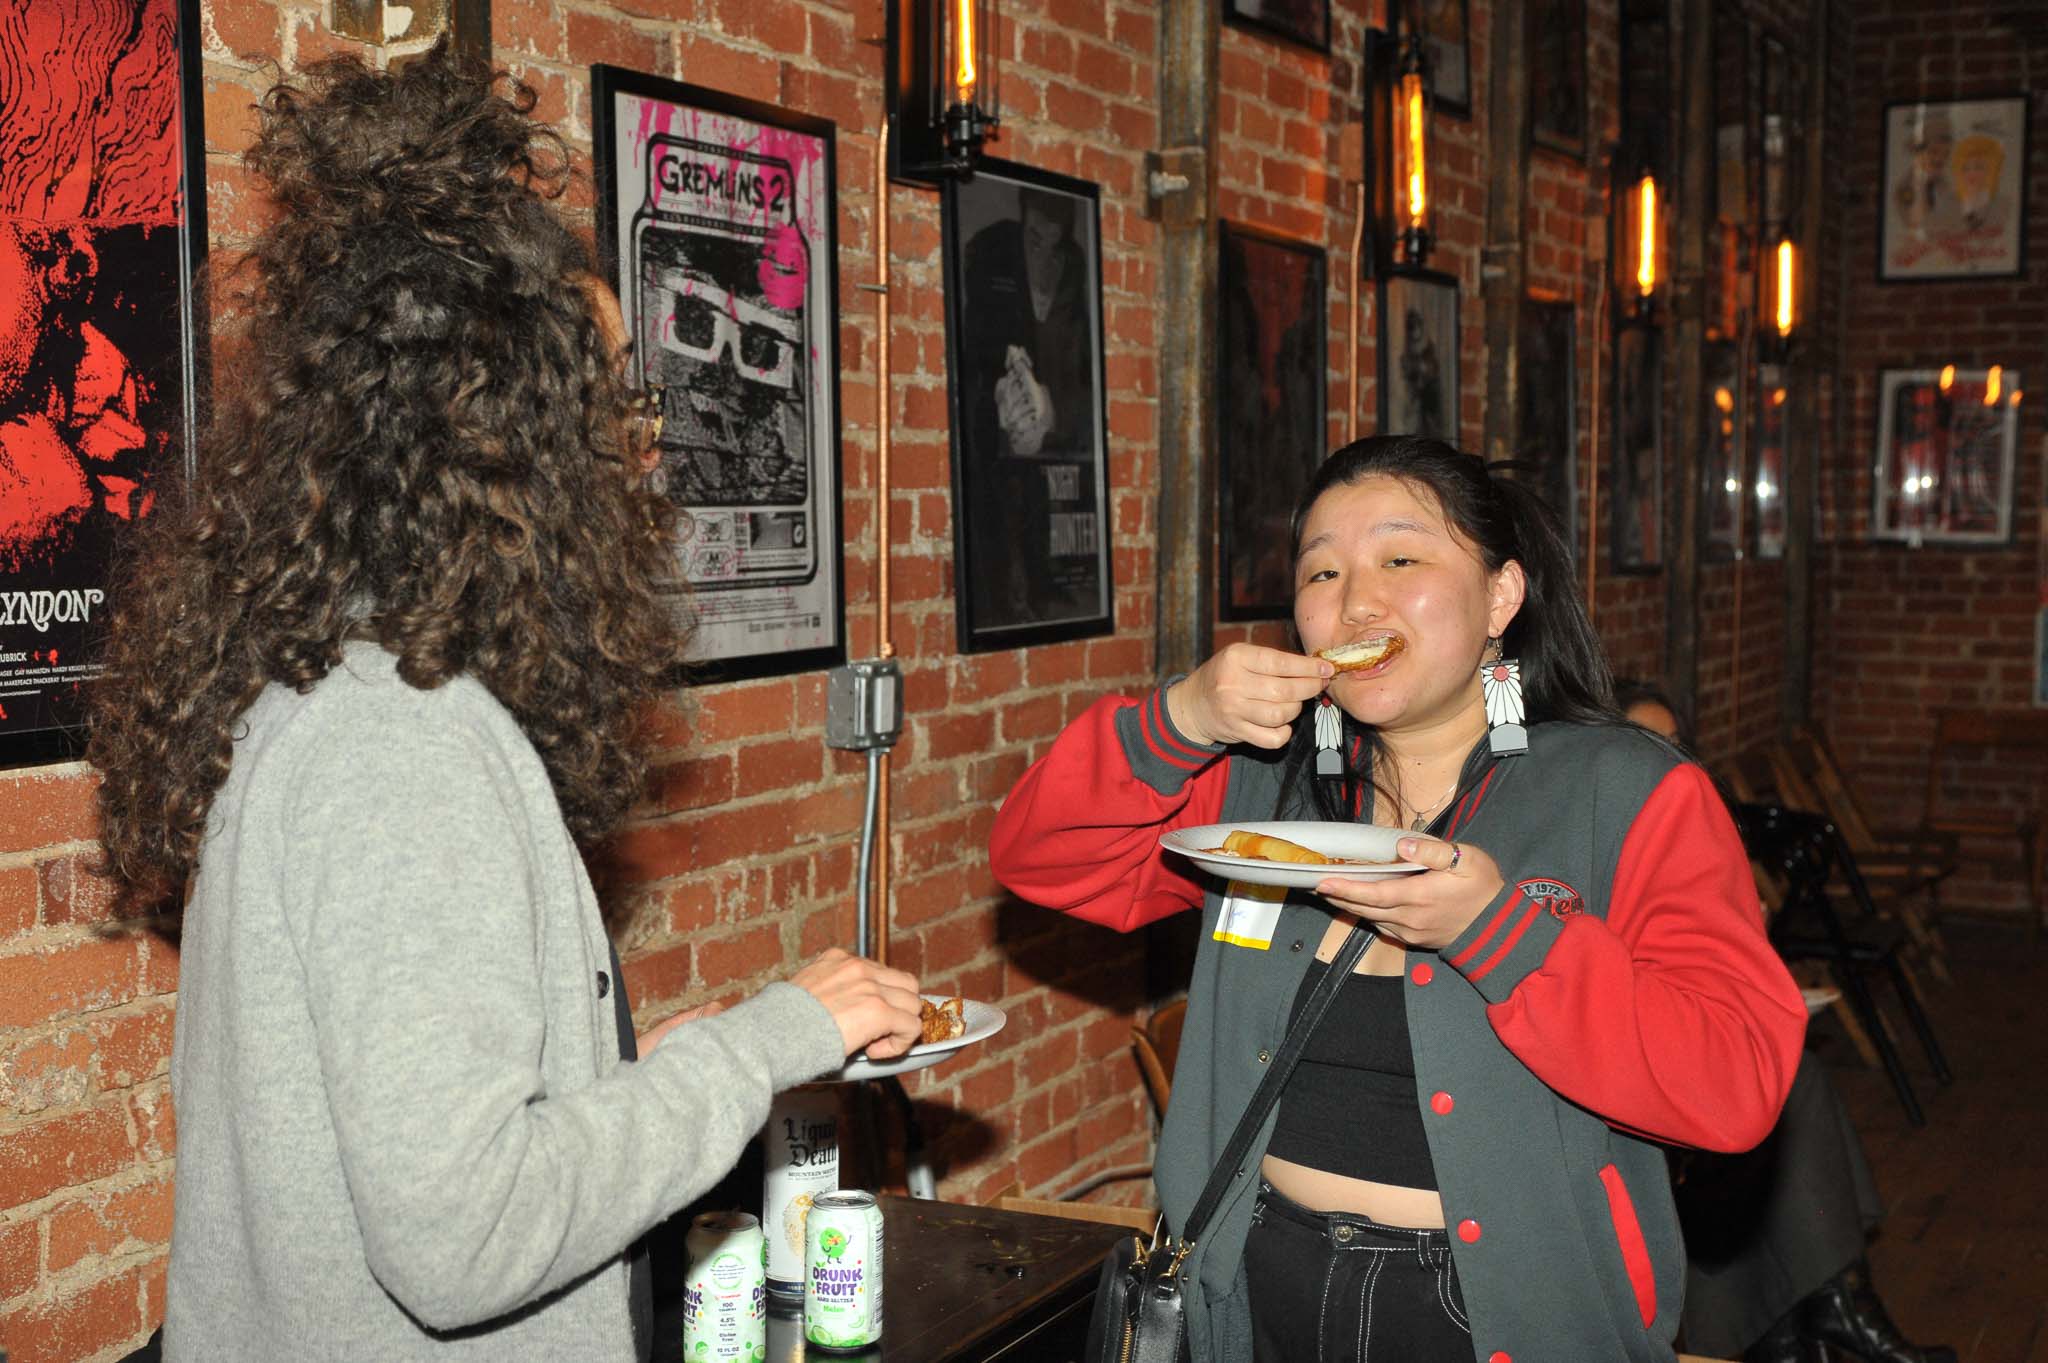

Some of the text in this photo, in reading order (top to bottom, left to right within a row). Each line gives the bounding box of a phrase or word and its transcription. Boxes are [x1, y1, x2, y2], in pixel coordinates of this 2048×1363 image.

[658, 155, 765, 209] GREMLINS
[770, 175, 784, 211] 2
[0, 588, 104, 632] YNDON
[1536, 883, 1561, 897] 1972
[813, 1267, 863, 1282] DRUNK
[816, 1281, 857, 1296] FRUIT
